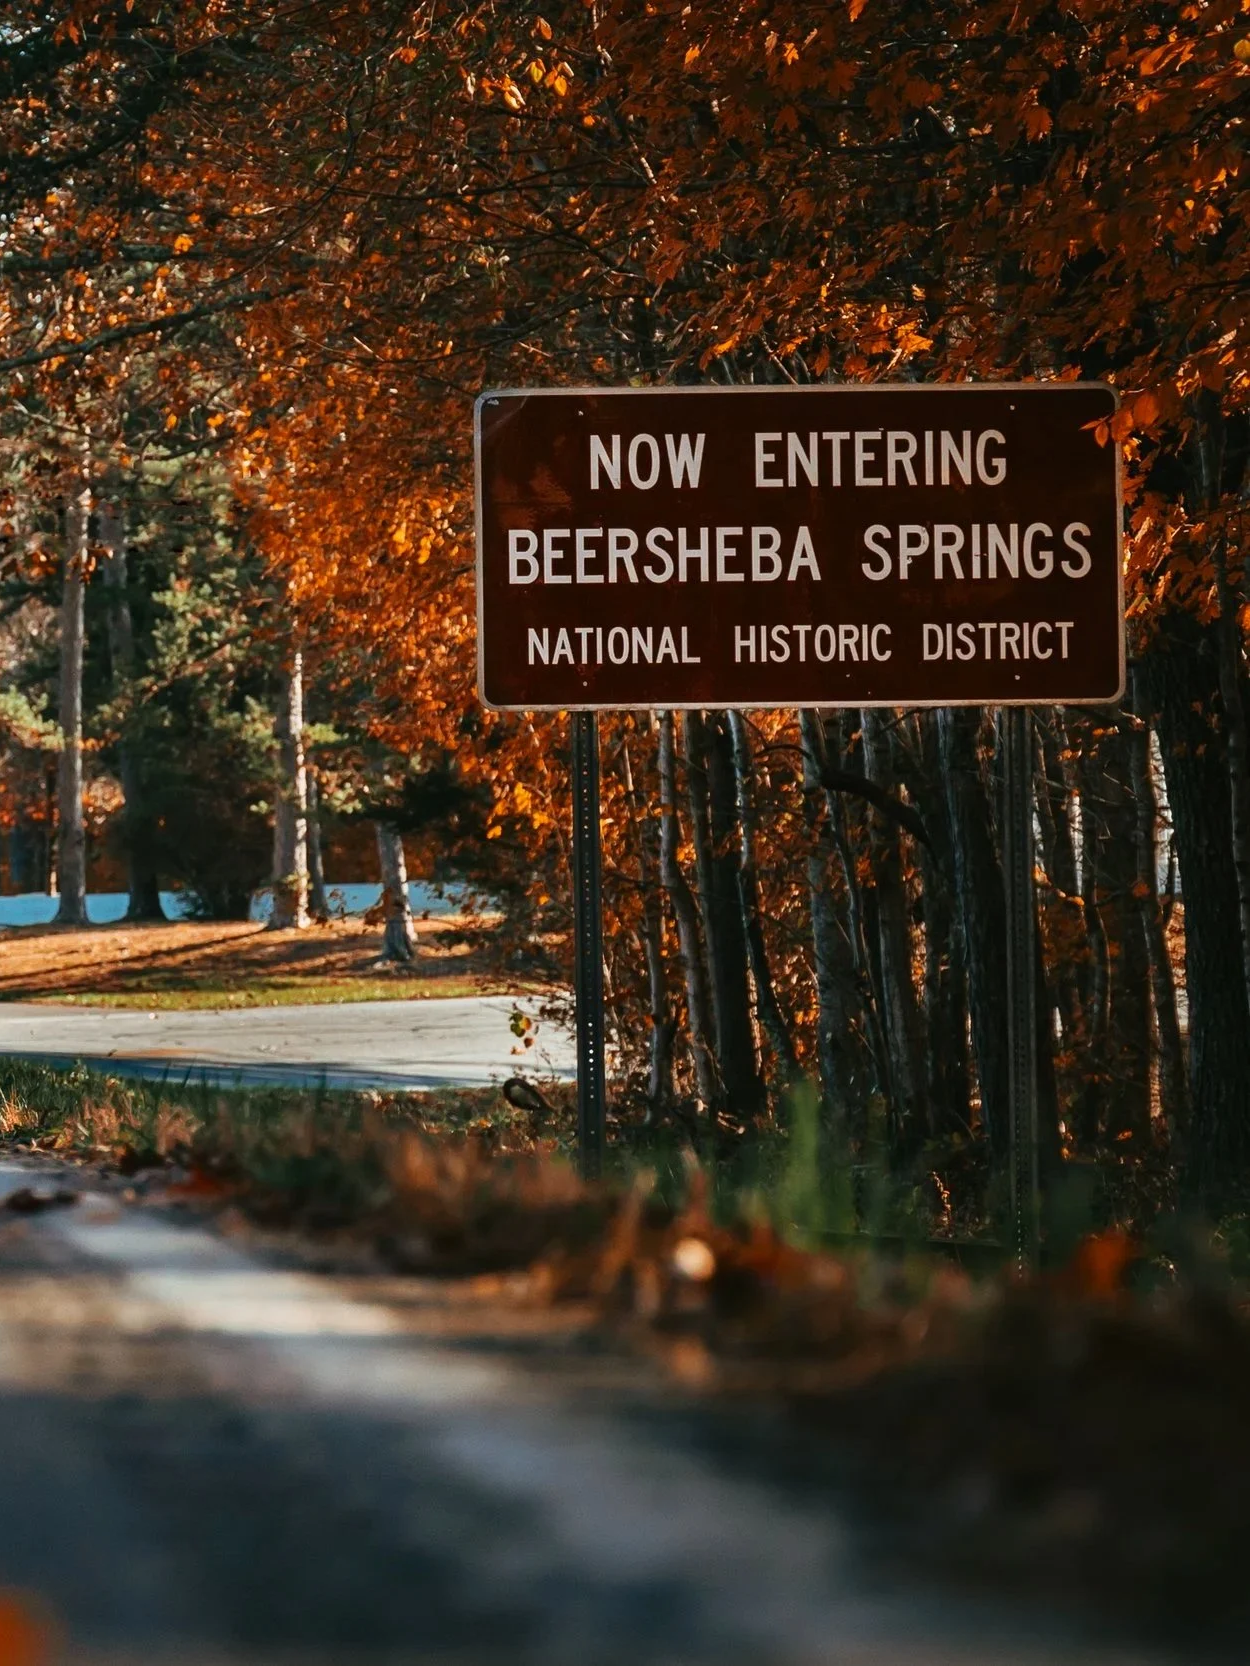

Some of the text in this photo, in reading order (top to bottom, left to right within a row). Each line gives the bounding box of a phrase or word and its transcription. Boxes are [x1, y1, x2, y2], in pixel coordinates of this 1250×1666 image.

[590, 429, 1007, 490] NOW ENTERING
[508, 522, 1092, 585] BEERSHEBA SPRINGS
[527, 621, 1074, 666] NATIONAL HISTORIC DISTRICT
